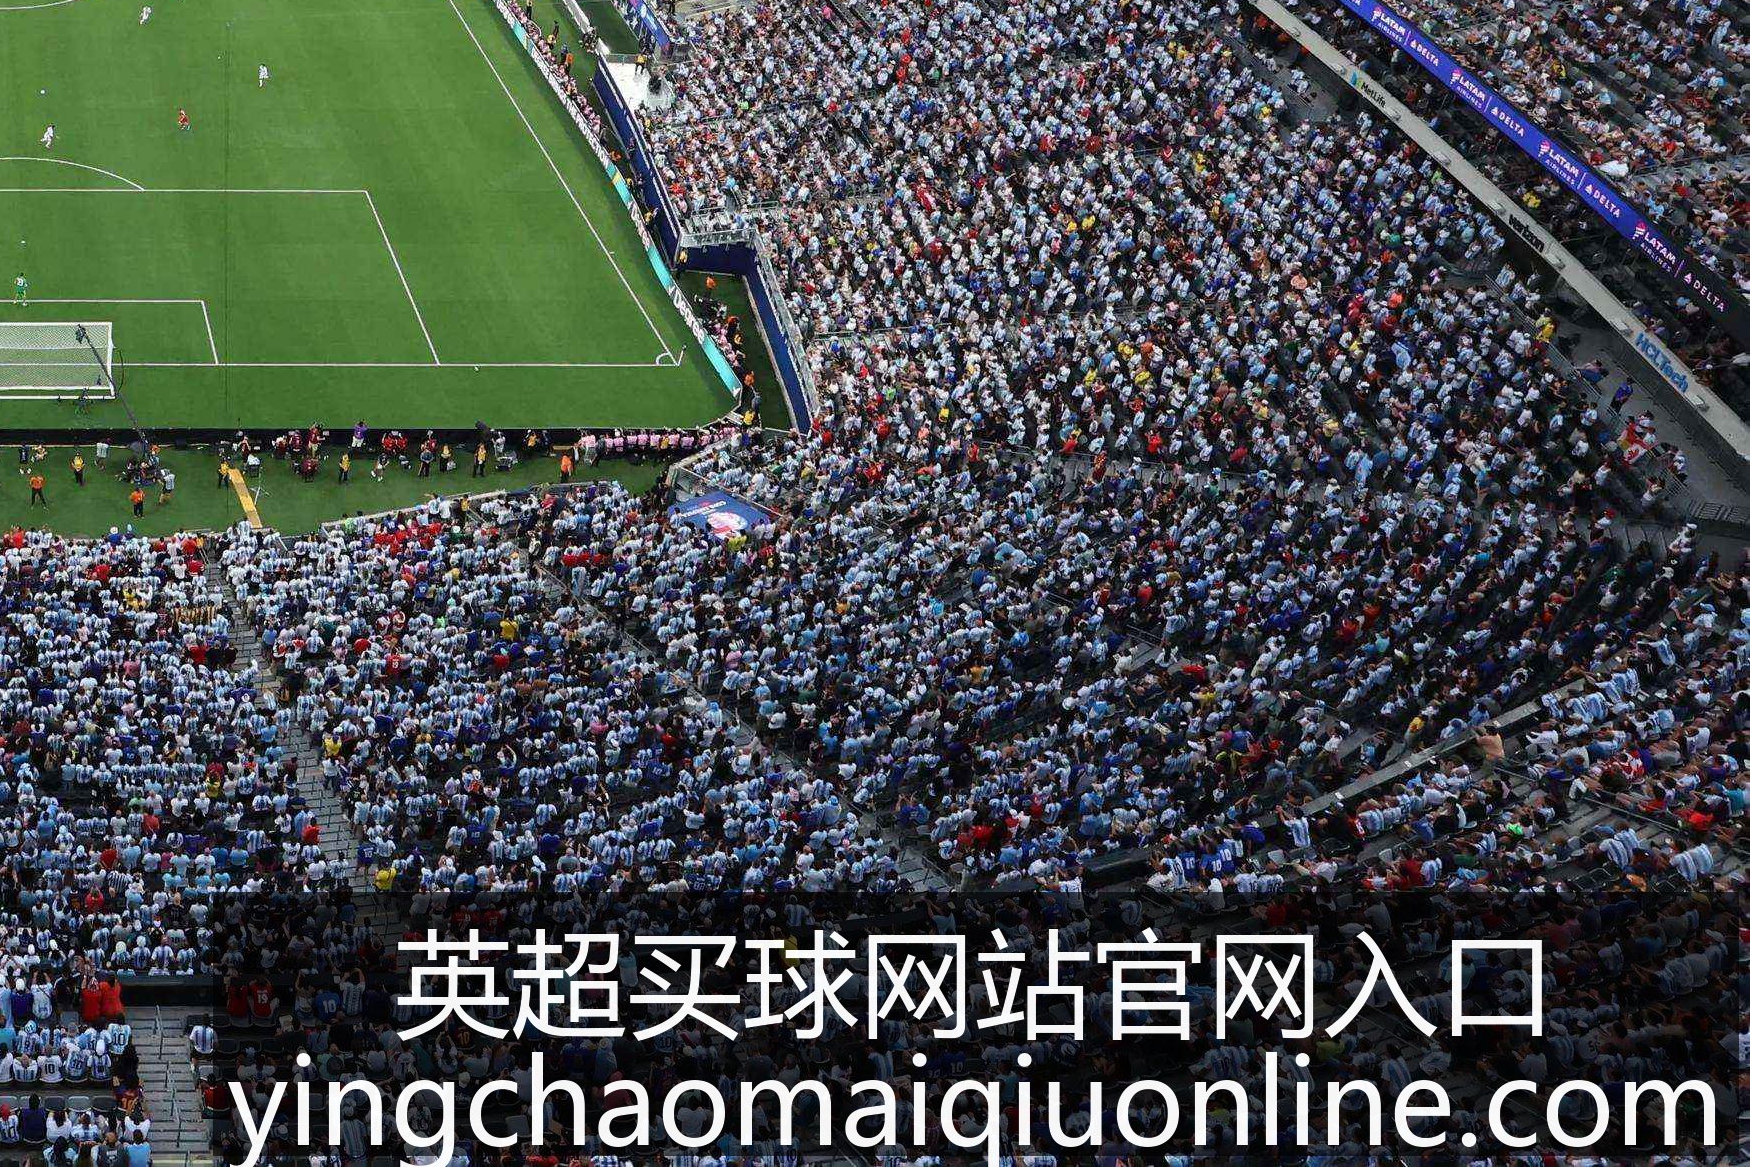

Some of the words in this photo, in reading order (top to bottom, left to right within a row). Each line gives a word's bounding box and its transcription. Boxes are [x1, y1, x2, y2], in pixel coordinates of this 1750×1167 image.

[1381, 13, 1406, 37] LATAM
[1416, 43, 1440, 67] DELTA
[1459, 75, 1486, 103] LATAM
[1498, 111, 1525, 137] DELTA
[1550, 149, 1580, 178] LATAM
[1592, 188, 1621, 219] DELTA
[1644, 232, 1677, 266] LATAM
[1693, 280, 1726, 313] DELTA
[673, 292, 705, 344] Degree
[1635, 331, 1689, 393] HCLTech
[1185, 857, 1195, 870] 10
[1211, 859, 1222, 872] 10
[1220, 848, 1232, 862] 10
[322, 1000, 337, 1013] 10
[113, 1032, 126, 1045] 10
[44, 1063, 55, 1076] 10
